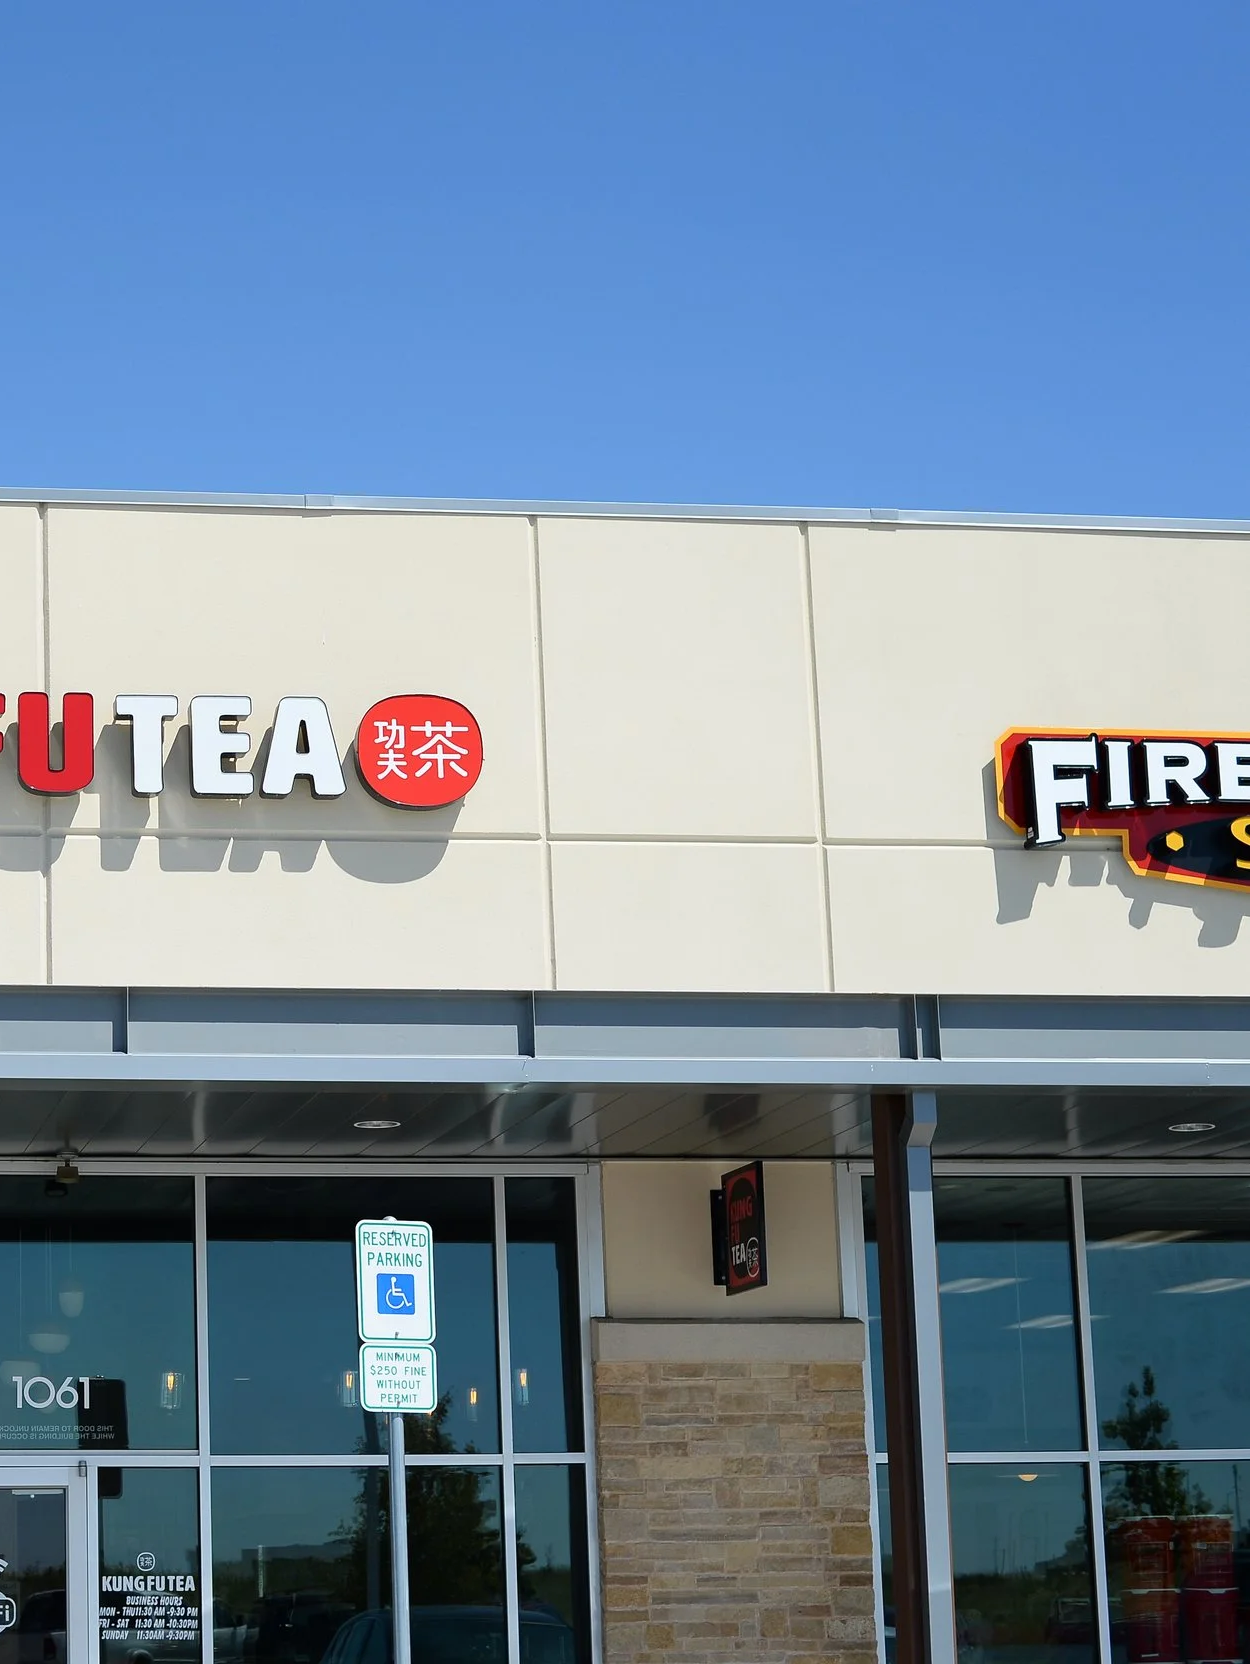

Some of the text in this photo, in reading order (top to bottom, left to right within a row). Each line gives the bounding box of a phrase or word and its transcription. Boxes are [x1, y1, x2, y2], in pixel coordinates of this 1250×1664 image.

[114, 694, 347, 798] TEA
[363, 1231, 427, 1248] RESERVED
[367, 1252, 423, 1268] PARKING
[731, 1243, 746, 1267] TEA
[376, 1352, 420, 1363] MINIMUM
[370, 1365, 427, 1377] $250 FINE
[376, 1380, 421, 1390] WITHOUT
[12, 1376, 90, 1409] 1061
[380, 1393, 418, 1404] PERMIT
[102, 1576, 196, 1591] KUNG FU TEA
[126, 1596, 183, 1606] BUSINESS HOURS
[99, 1607, 116, 1616] MON
[154, 1607, 165, 1616] AM
[187, 1607, 198, 1616] PM
[99, 1619, 110, 1627] FRI
[117, 1619, 129, 1628] SAT
[135, 1619, 152, 1628] 11:30
[154, 1619, 165, 1628] AM
[101, 1631, 129, 1639] SUNDAY
